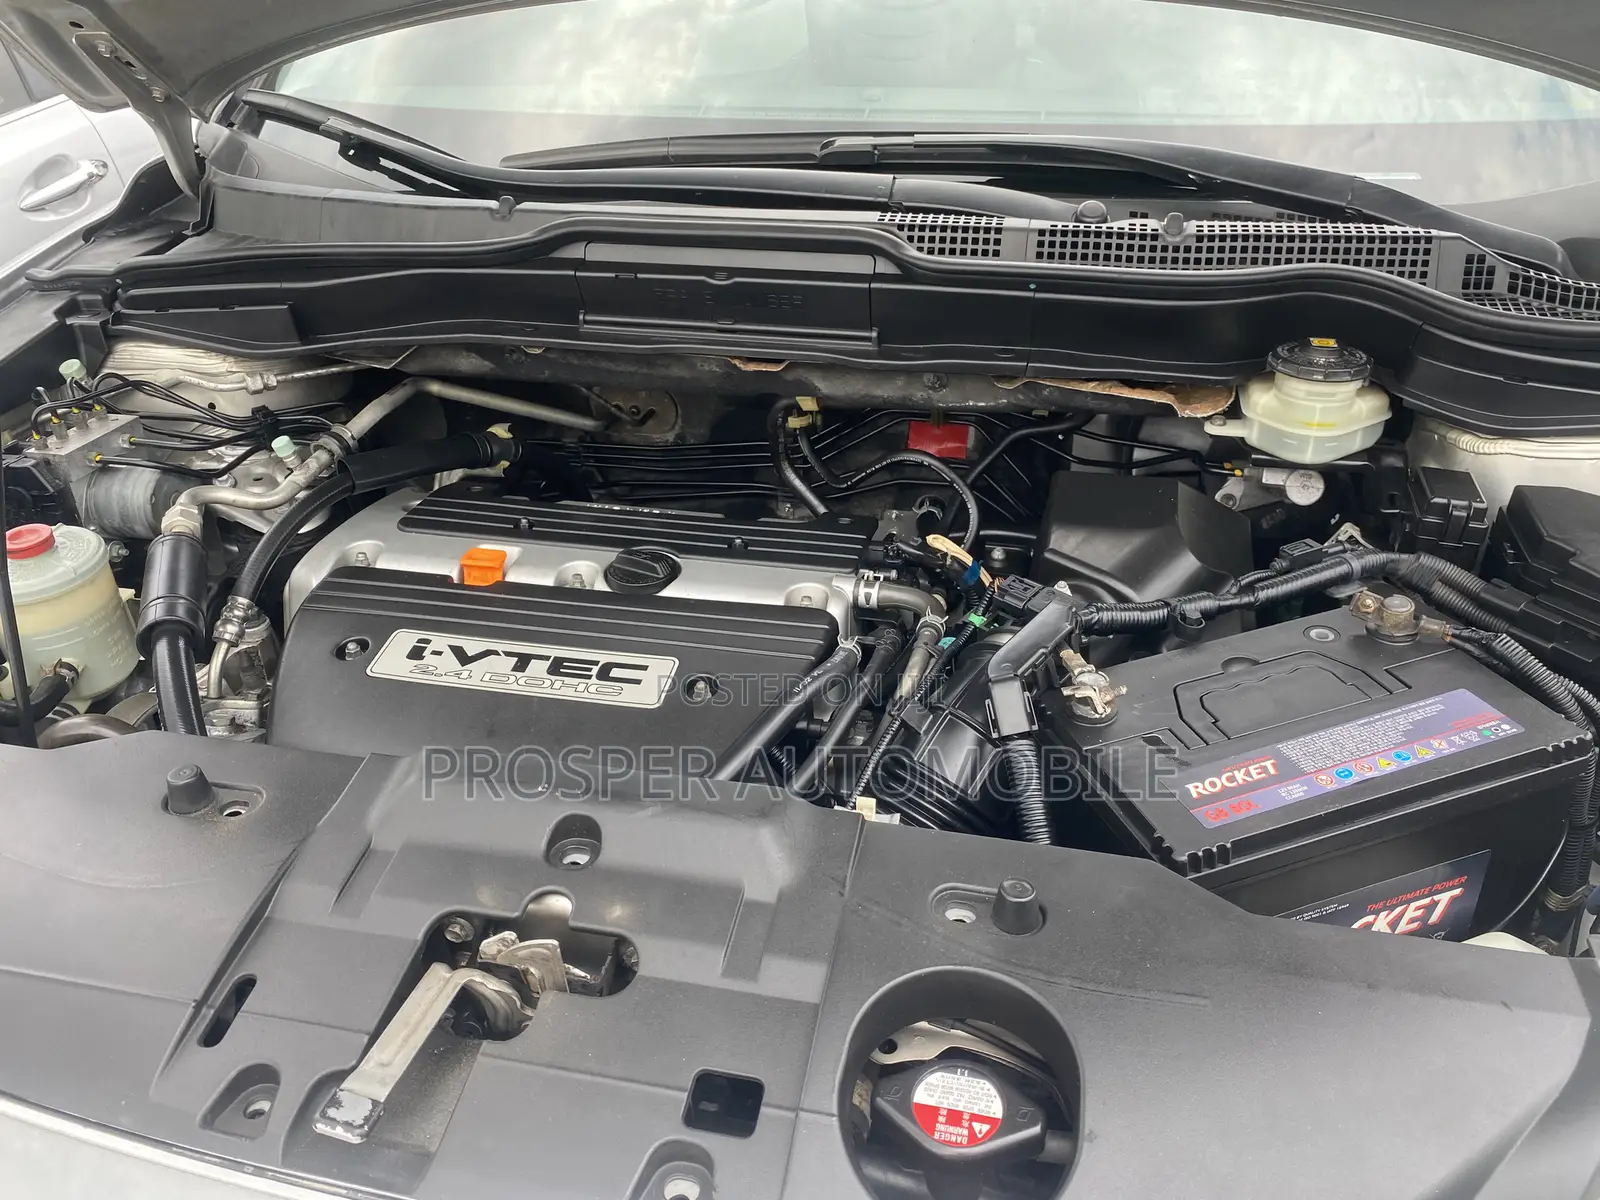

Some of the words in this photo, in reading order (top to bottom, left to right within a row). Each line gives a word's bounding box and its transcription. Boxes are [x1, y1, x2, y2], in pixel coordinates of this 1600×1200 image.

[405, 637, 649, 685] i-VTEC
[409, 663, 473, 680] 2.4
[479, 671, 624, 697] DOHC
[1185, 759, 1279, 799] ROCKET
[1351, 888, 1464, 934] CKET
[1366, 901, 1384, 912] THE
[1386, 886, 1431, 907] ULTIMATE
[1432, 875, 1468, 892] POWER
[934, 1131, 969, 1145] DANGER
